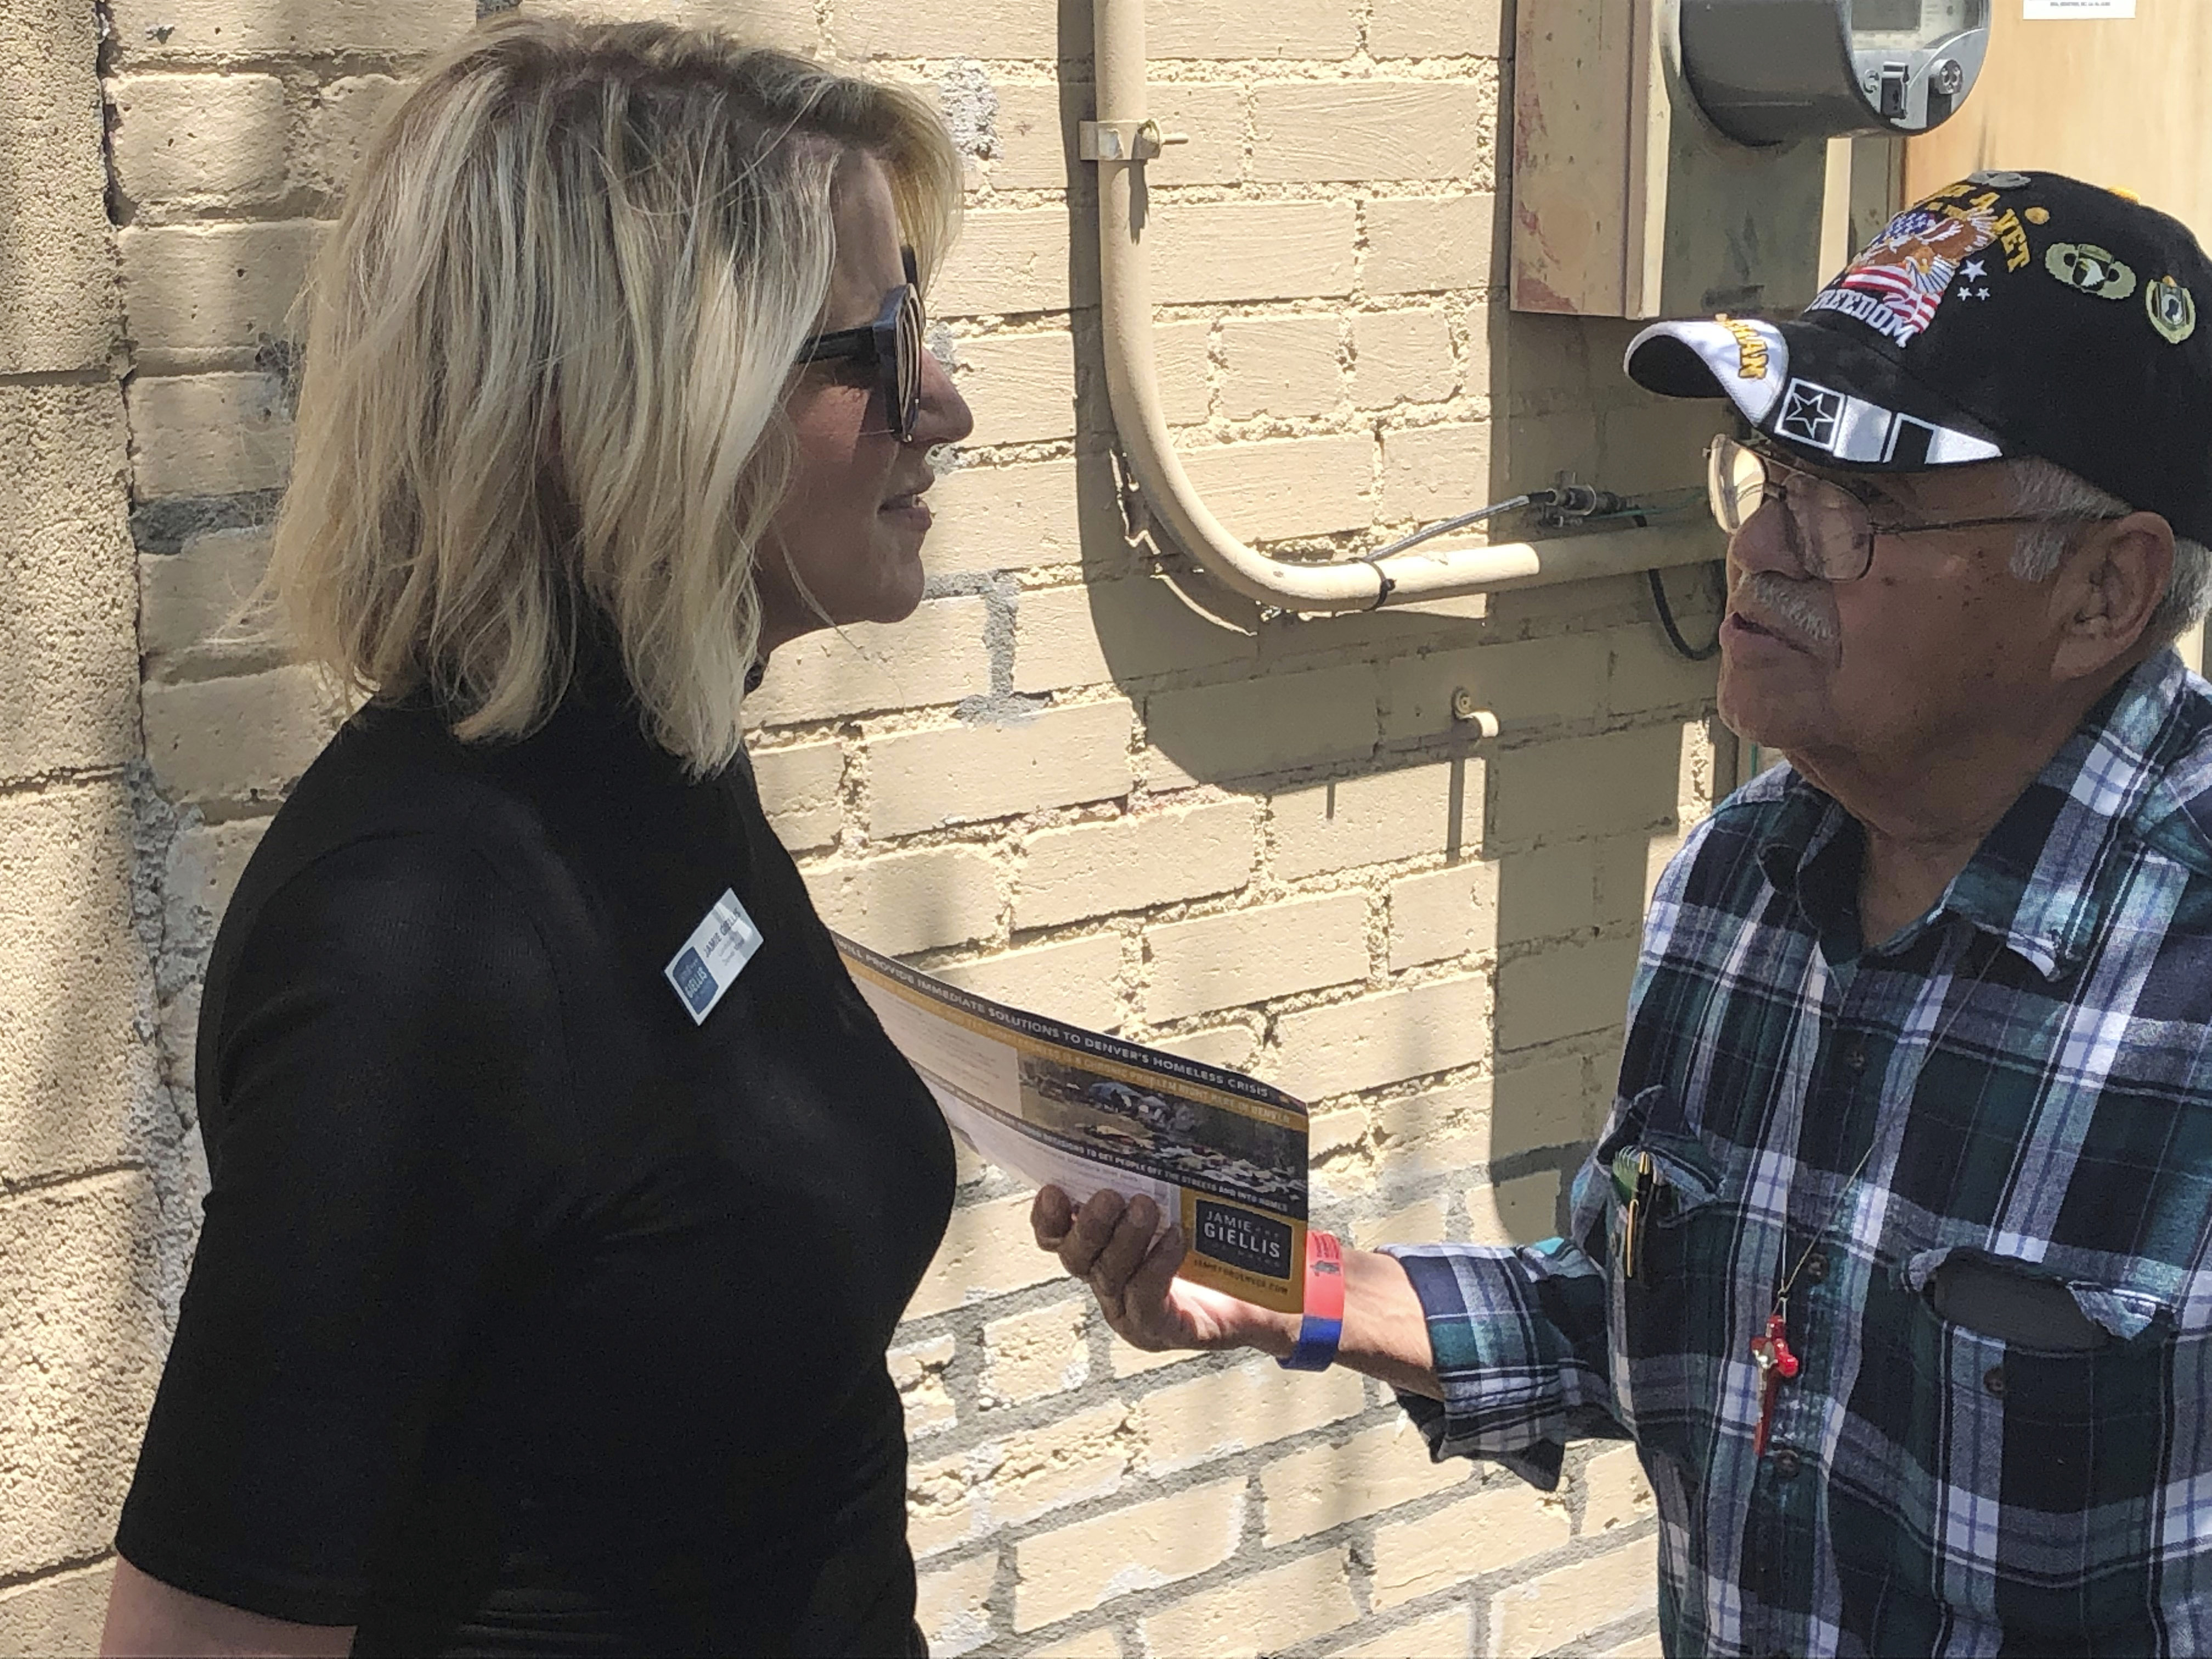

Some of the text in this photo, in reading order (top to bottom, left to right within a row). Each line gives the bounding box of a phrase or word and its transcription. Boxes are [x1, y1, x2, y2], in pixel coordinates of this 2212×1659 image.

[1993, 208, 2030, 273] VET
[1803, 289, 1916, 348] FREEDOM
[836, 938, 1268, 1097] WILL PROVIDE IMMEDIATE SOLUTIONS TO DENVER'S HOMELESS CRISIS
[1204, 1222, 1280, 1259] GIELLIS
[1207, 1210, 1252, 1233] JAMIE
